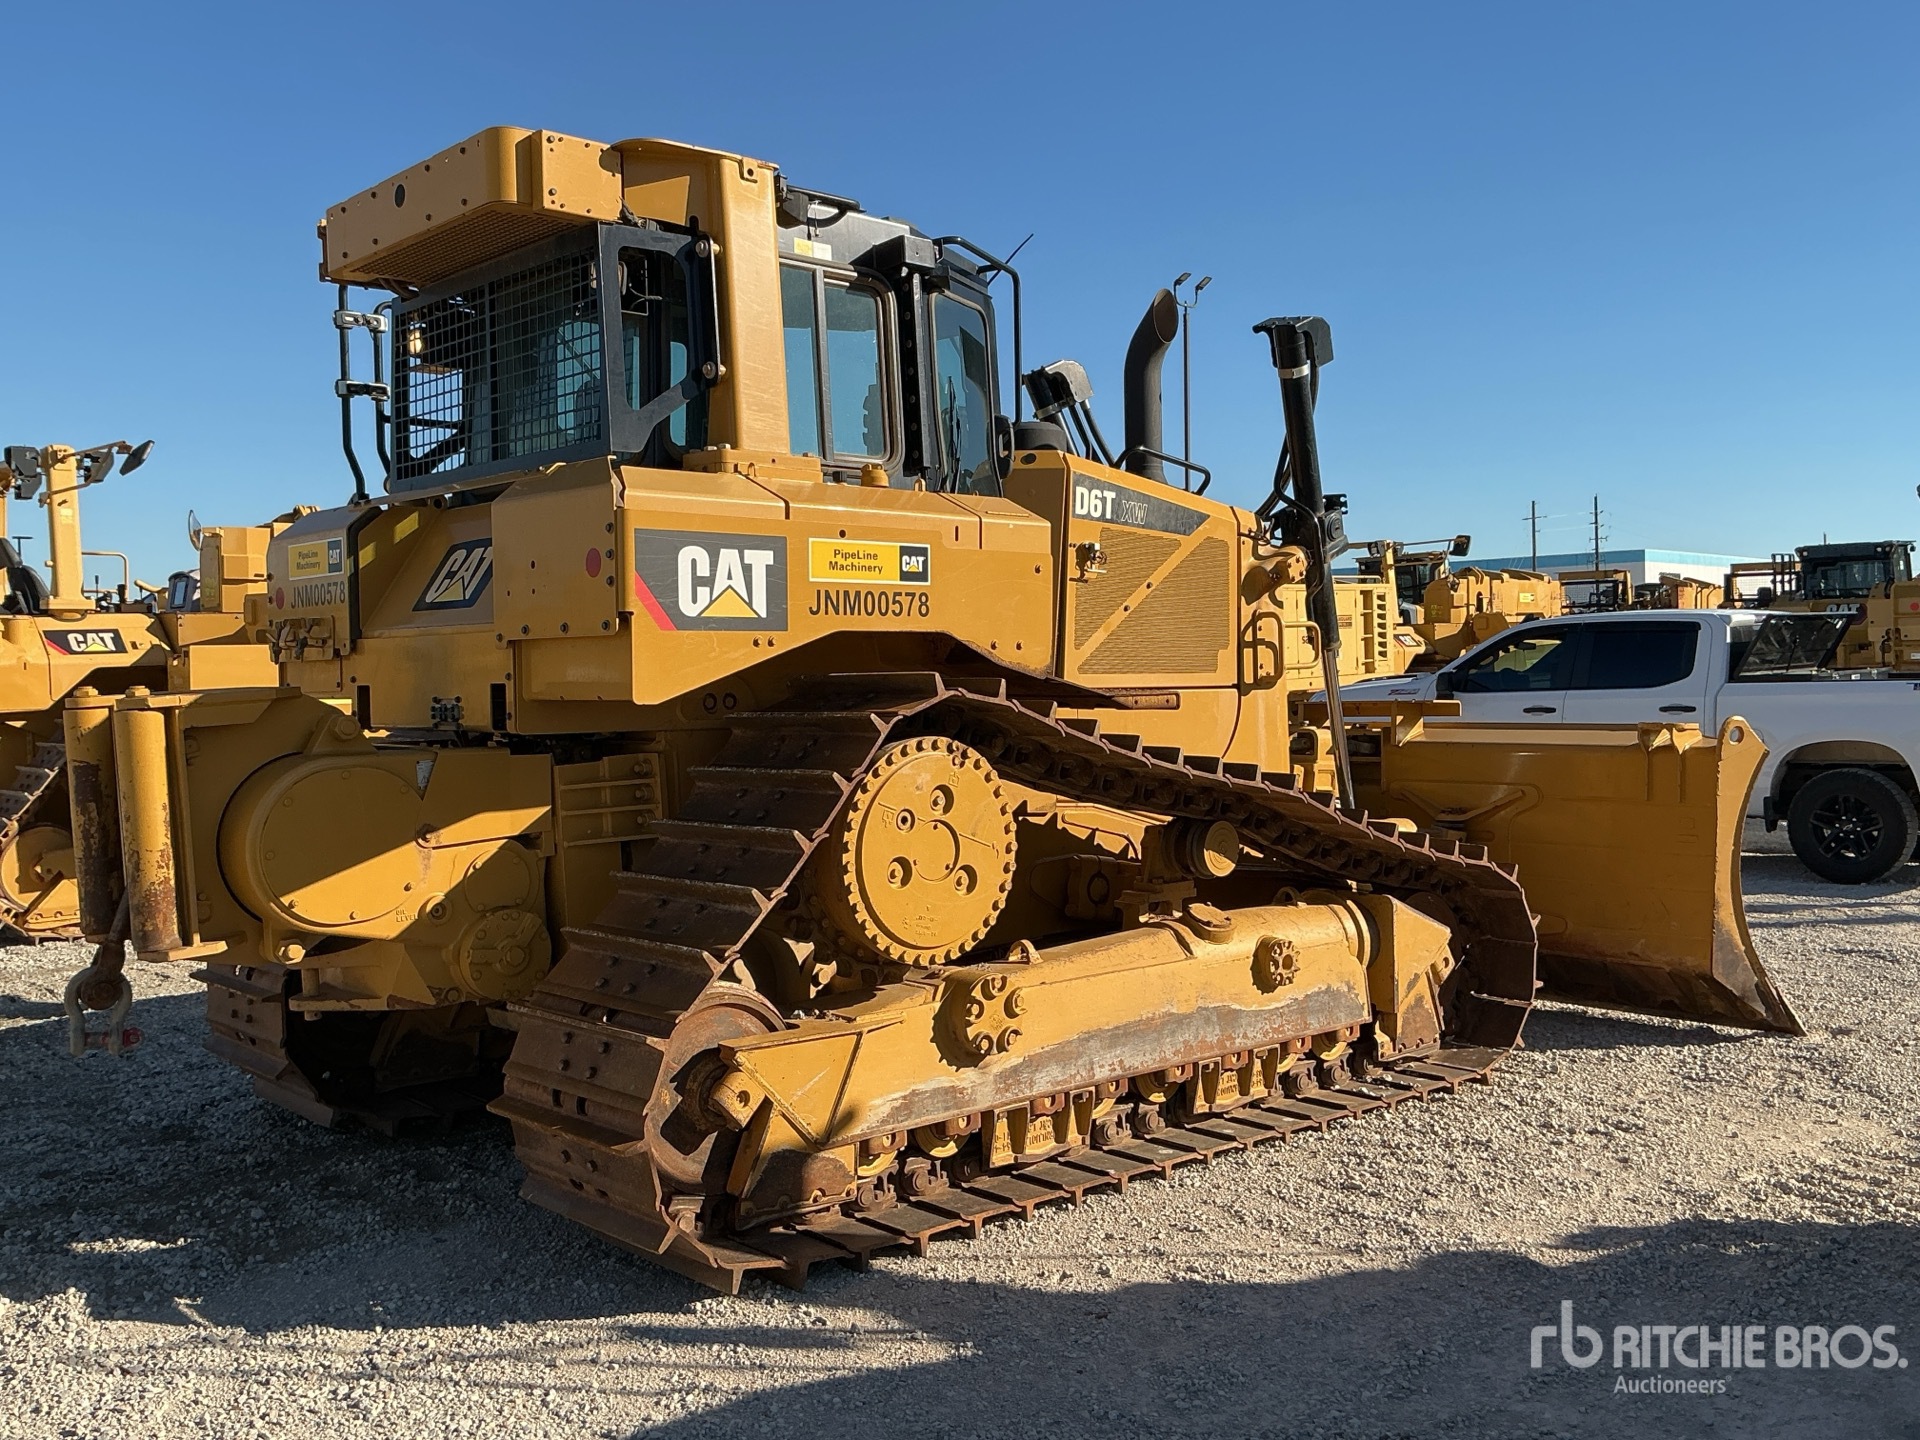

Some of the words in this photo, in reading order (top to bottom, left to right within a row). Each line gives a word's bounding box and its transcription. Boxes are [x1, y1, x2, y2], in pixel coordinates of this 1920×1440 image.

[1075, 486, 1116, 520] D6T
[297, 550, 319, 561] PipeLine
[329, 549, 341, 564] CAT
[833, 549, 878, 561] PipeLine
[902, 555, 926, 573] CAT
[296, 561, 321, 570] Machinery
[425, 546, 493, 603] CAT
[828, 561, 883, 575] Machinery
[677, 545, 774, 619] CAT
[291, 581, 346, 609] JNM00578
[809, 589, 930, 617] JNM00578
[67, 632, 116, 652] CAT
